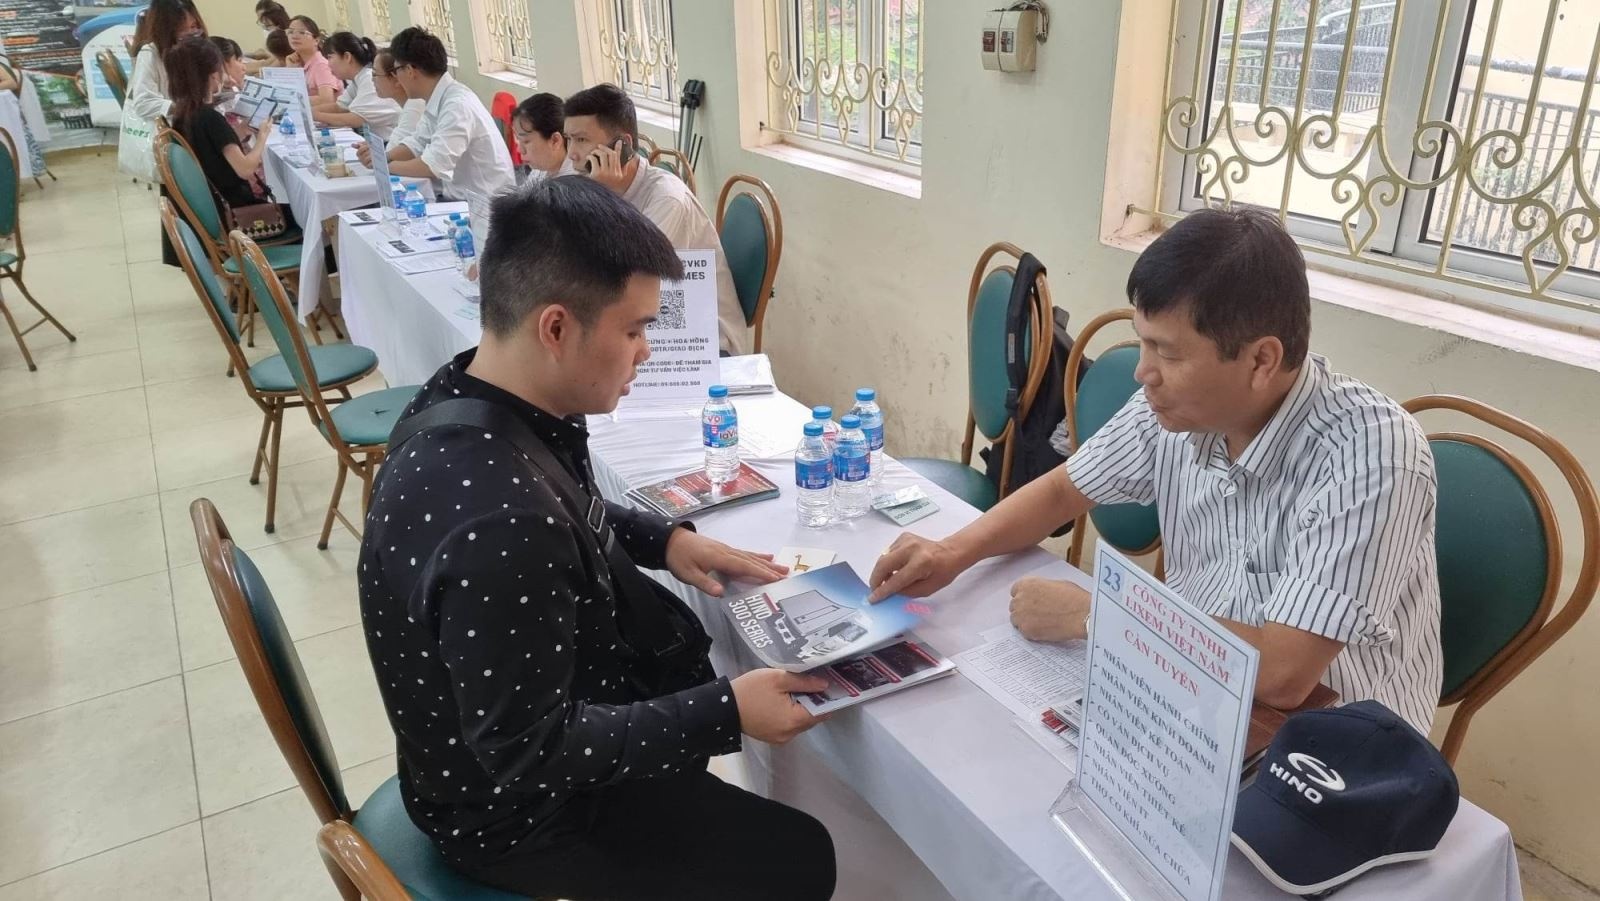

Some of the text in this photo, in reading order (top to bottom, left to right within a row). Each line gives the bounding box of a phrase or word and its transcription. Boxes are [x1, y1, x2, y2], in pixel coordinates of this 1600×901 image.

[1103, 565, 1122, 594] 23
[728, 599, 774, 648] 300 SERIES
[745, 594, 773, 620] HINO
[1132, 583, 1227, 661] CÔNG TY TNHH
[1126, 597, 1230, 684] LIXEM VIỆT NAM
[1150, 711, 1176, 739] KINH
[1178, 735, 1216, 774] DOANH
[1183, 717, 1219, 753] CHÍNH
[1269, 762, 1323, 804] HINO
[1139, 806, 1150, 821] IT
